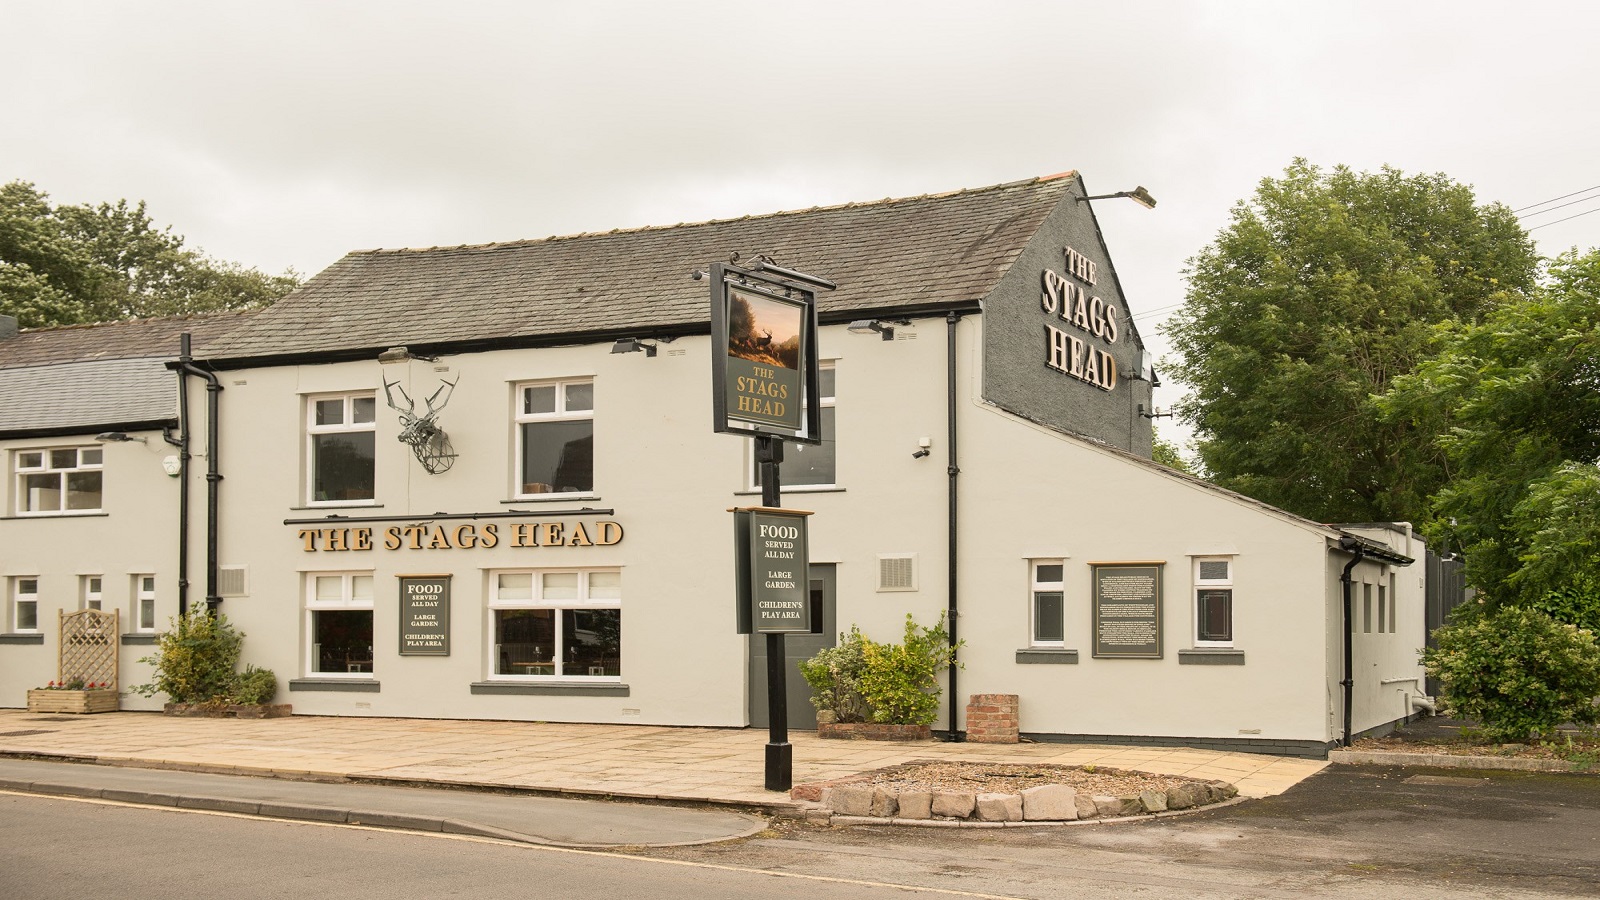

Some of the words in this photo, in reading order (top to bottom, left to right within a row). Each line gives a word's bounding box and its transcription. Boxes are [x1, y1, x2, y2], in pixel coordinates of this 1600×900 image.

[1064, 245, 1097, 287] THE
[1042, 268, 1118, 345] STAGS
[1045, 324, 1117, 392] HEAD
[753, 366, 775, 379] THE
[736, 376, 788, 399] STAGS
[738, 395, 785, 417] HEAD
[298, 528, 373, 552] THE
[383, 523, 499, 550] STAGS
[510, 521, 624, 548] HEAD
[759, 524, 798, 539] FOOD
[765, 540, 793, 549] SERVED
[780, 551, 794, 559] DAY
[768, 571, 792, 579] LARGE
[407, 584, 443, 594] FOOD
[765, 581, 796, 589] GARDEN
[758, 600, 803, 609] CHILDREN'S
[762, 611, 780, 619] PLAY
[781, 611, 800, 619] AREA
